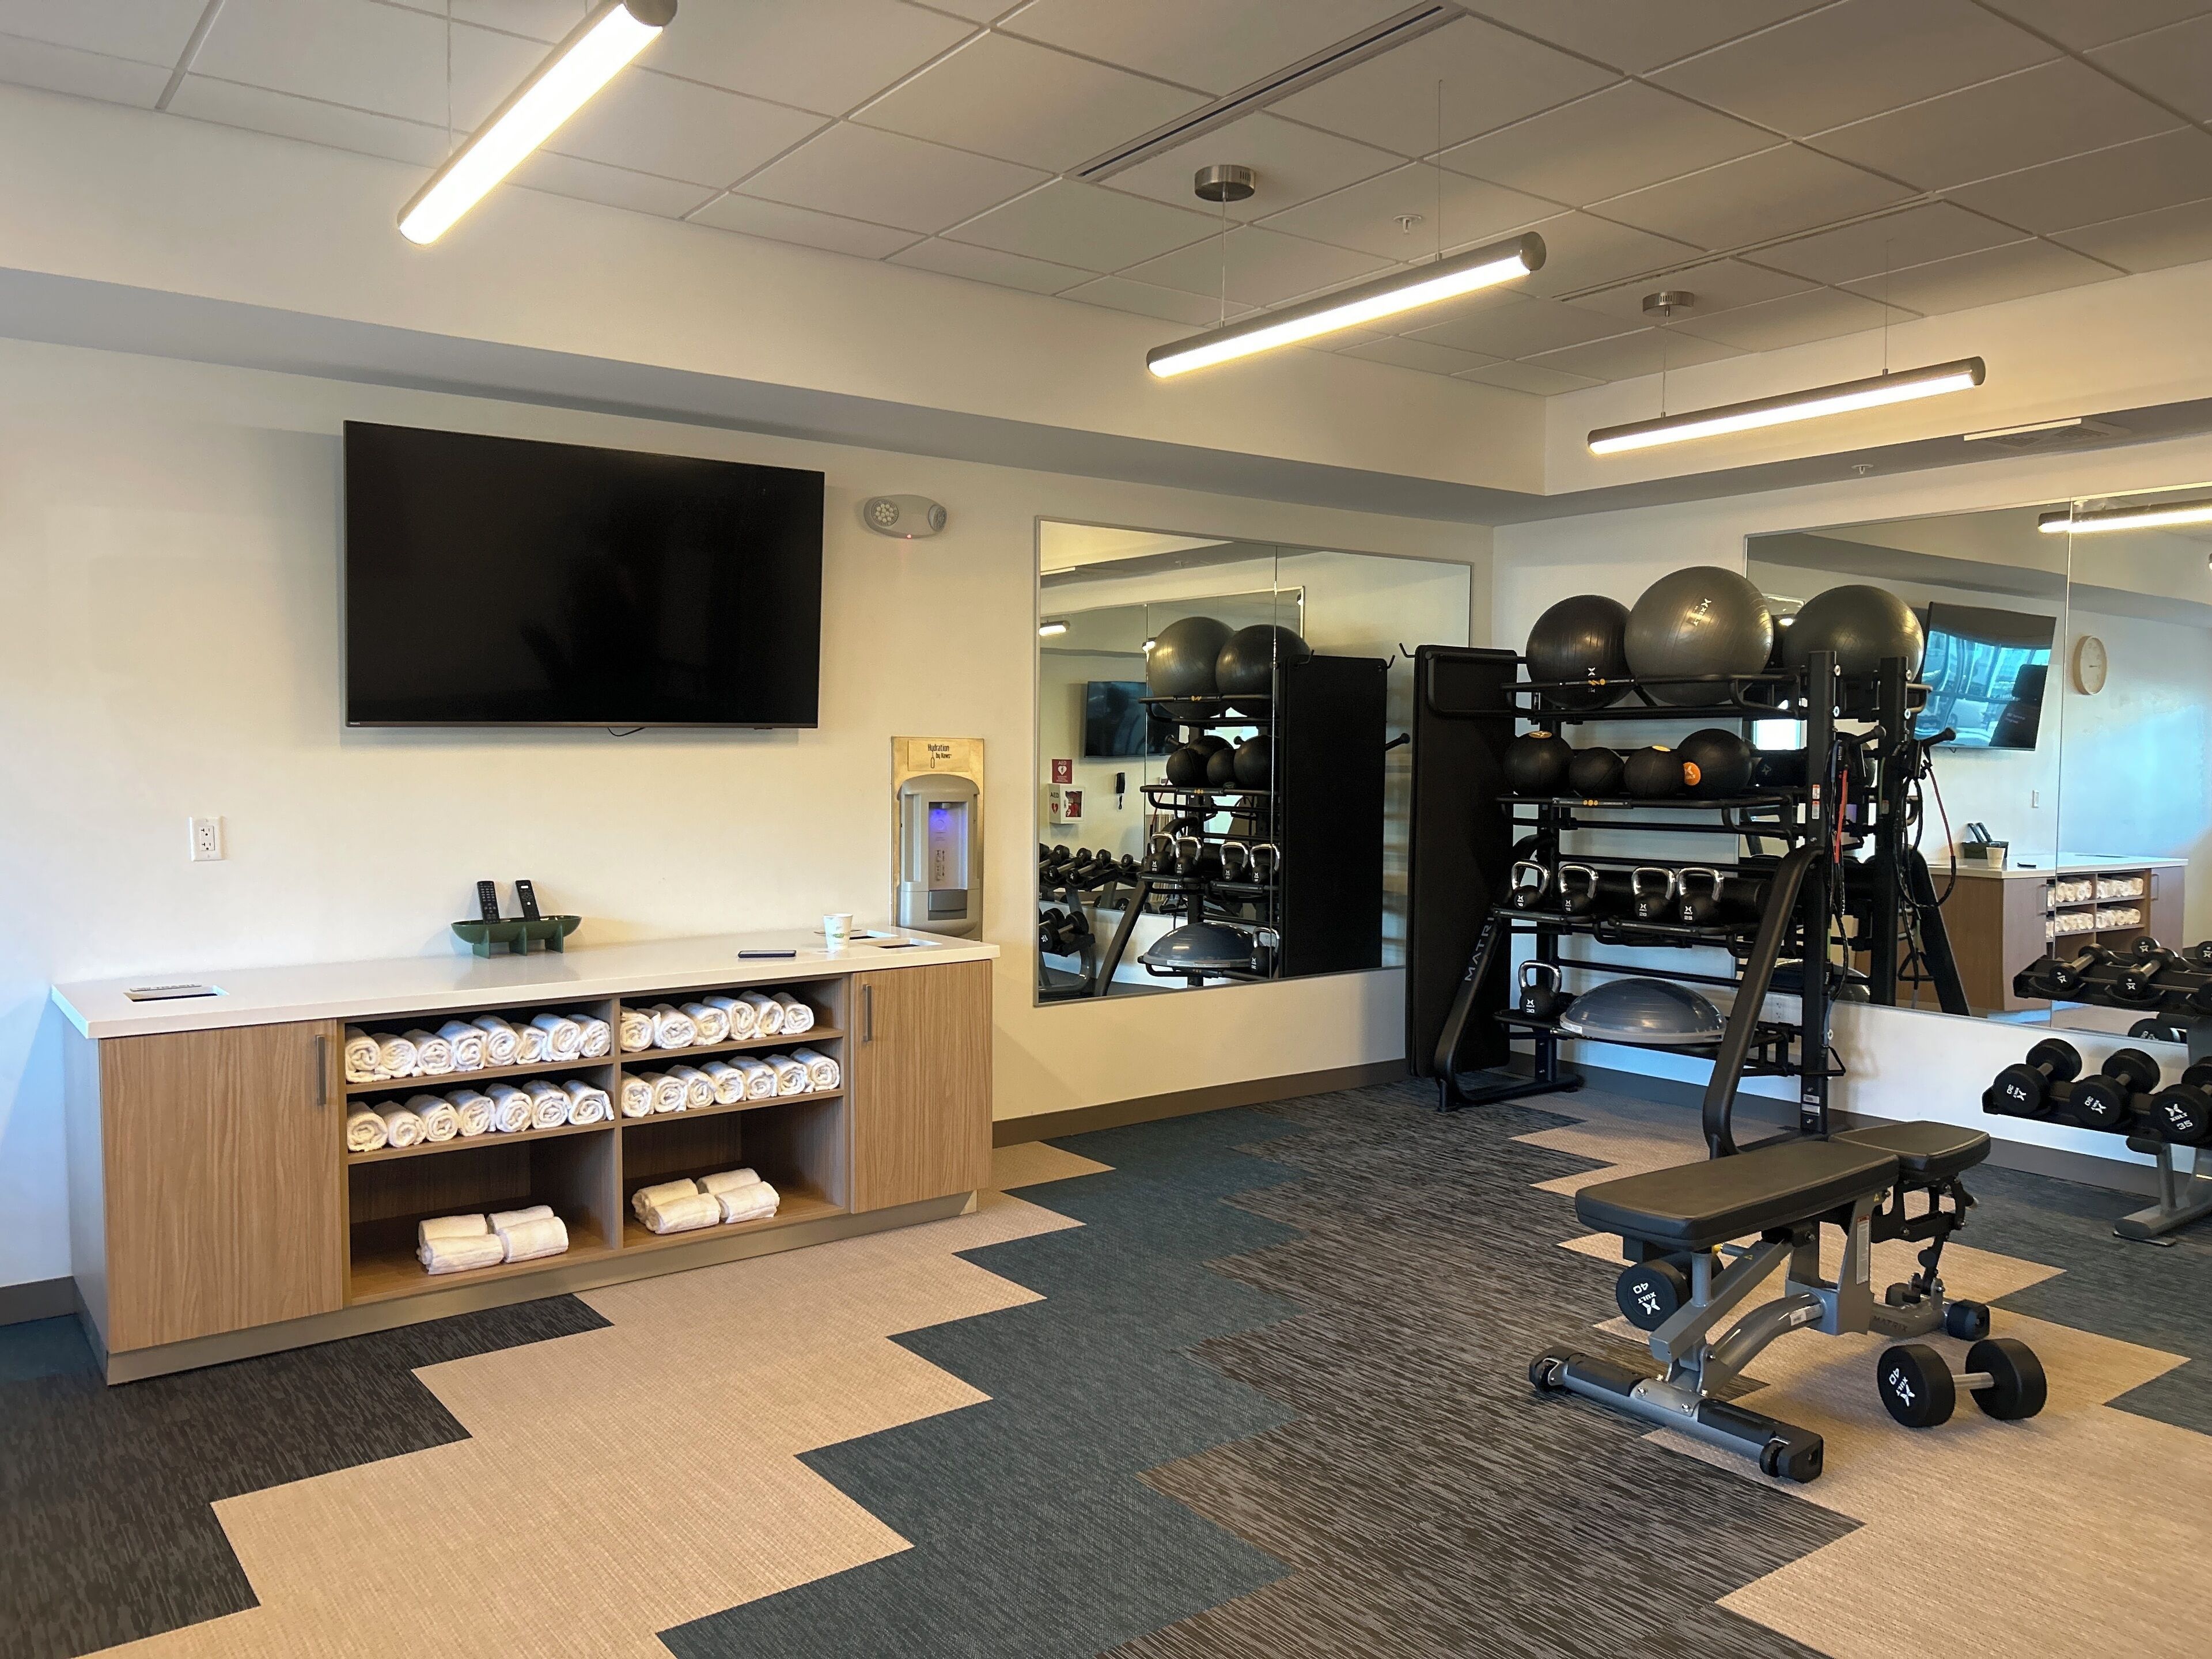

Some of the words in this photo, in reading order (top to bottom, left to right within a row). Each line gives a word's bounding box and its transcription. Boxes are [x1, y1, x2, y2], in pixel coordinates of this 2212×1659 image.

[927, 744, 949, 752] Hydration
[1464, 917, 1495, 981] MATRI
[2006, 1084, 2014, 1094] 30
[2084, 1096, 2094, 1107] 30
[2169, 1112, 2188, 1122] XULT
[2176, 1120, 2193, 1130] 35
[1633, 1282, 1649, 1294] 40
[1638, 1291, 1657, 1304] XULT
[1889, 1368, 1900, 1385] 40
[1895, 1376, 1908, 1396] XULT
